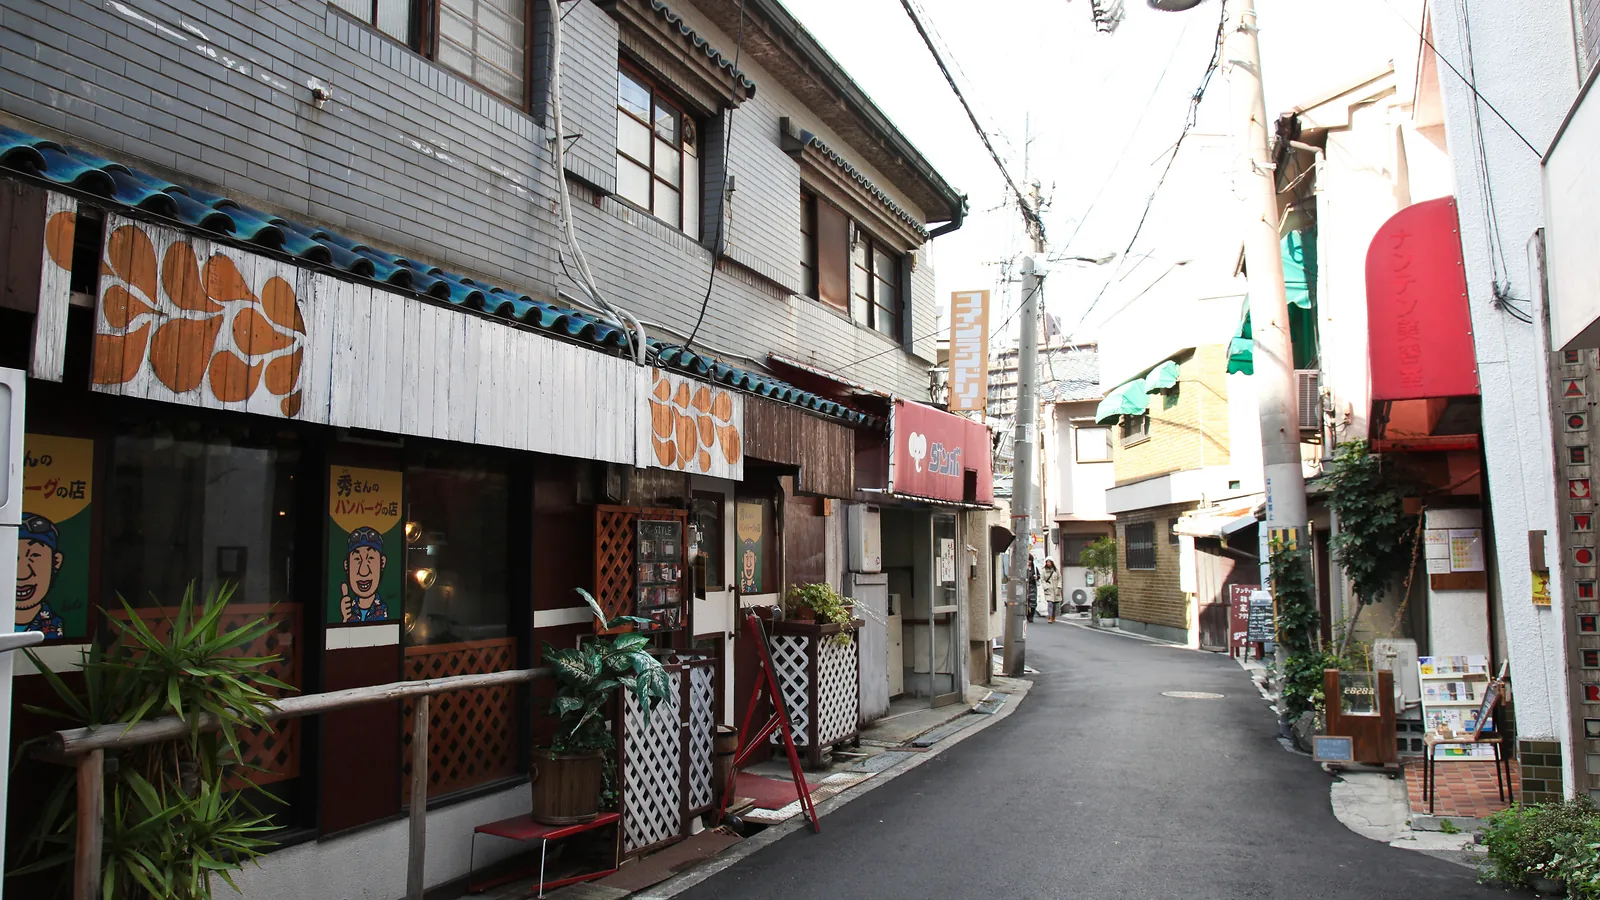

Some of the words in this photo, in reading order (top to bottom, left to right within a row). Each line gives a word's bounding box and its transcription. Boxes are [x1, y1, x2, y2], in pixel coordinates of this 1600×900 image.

[955, 293, 982, 408] コインランドリー
[928, 442, 962, 477] ダンボ
[336, 474, 380, 497] 秀さんの
[335, 499, 398, 517] ハンバーグの店
